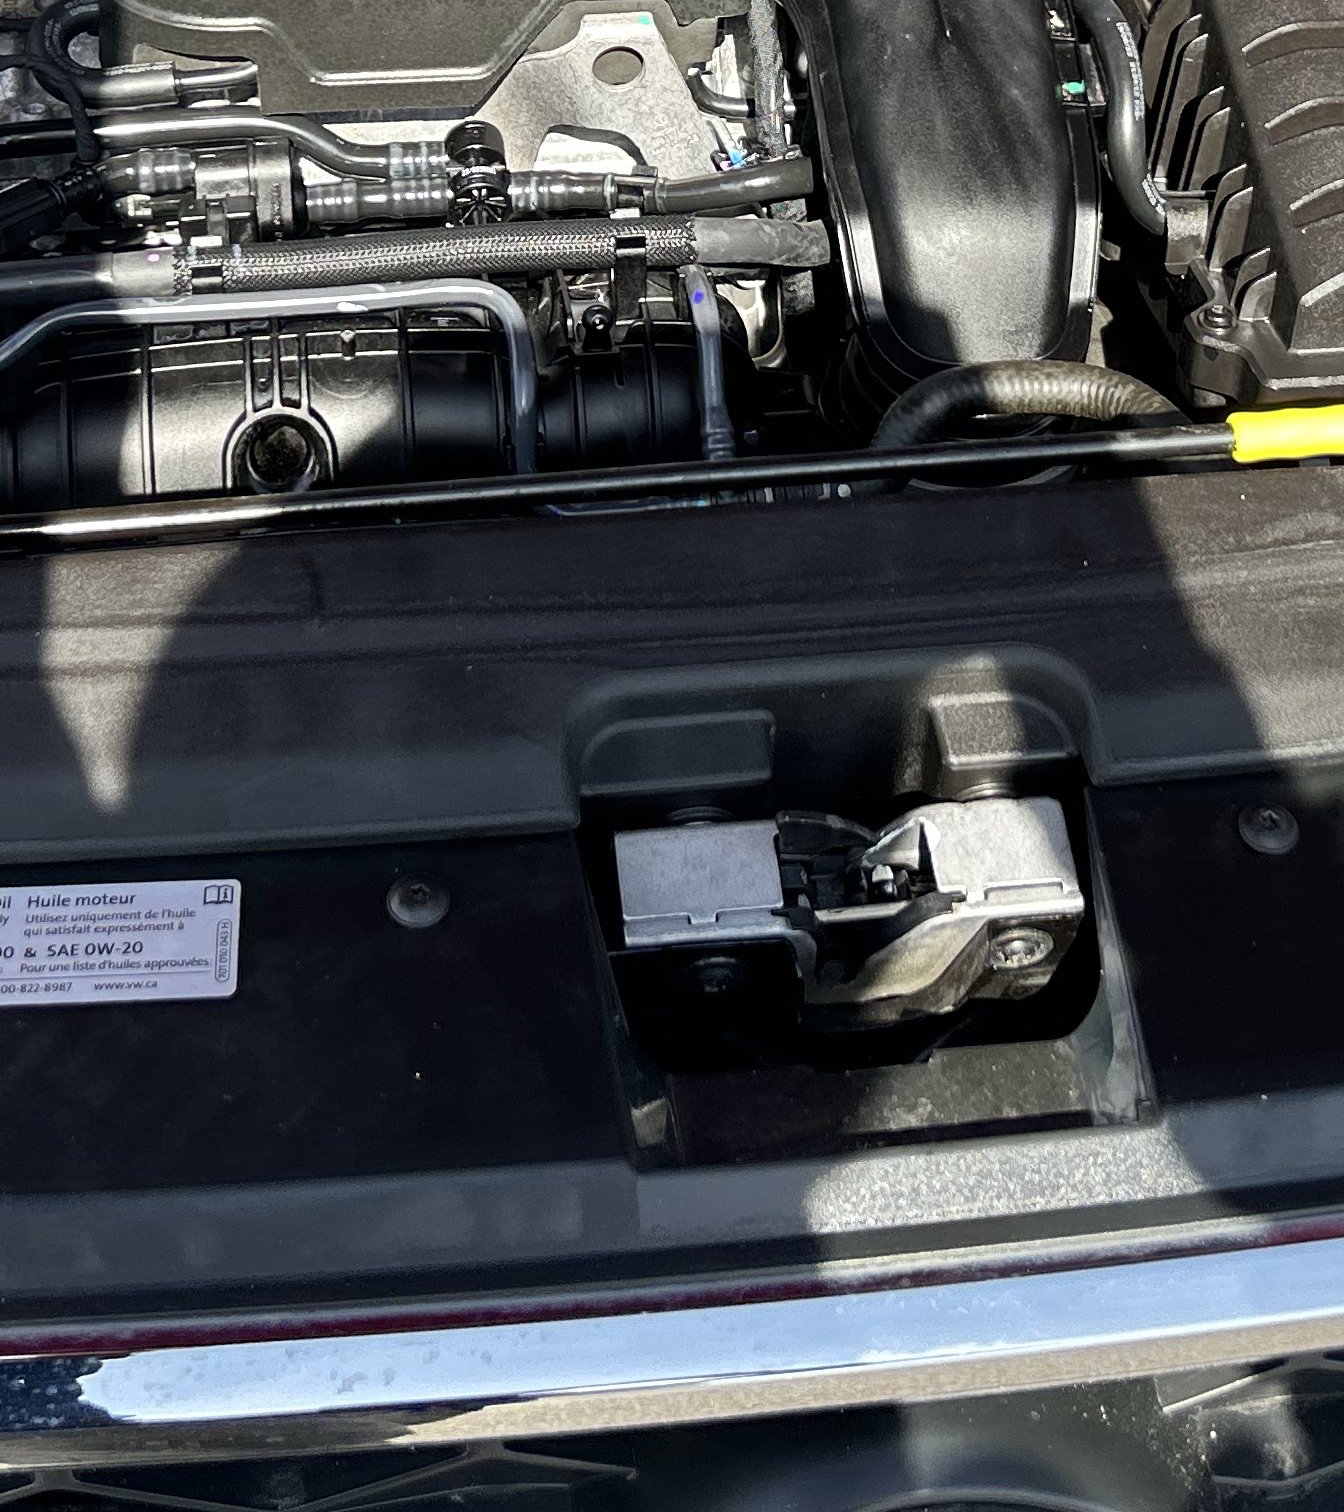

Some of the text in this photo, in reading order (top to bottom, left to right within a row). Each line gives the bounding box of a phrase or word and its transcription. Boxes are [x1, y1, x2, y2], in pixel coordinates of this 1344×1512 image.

[27, 890, 136, 909] Huile moteur
[25, 907, 196, 924] Utilisez uniquement de l'huile
[23, 920, 184, 938] qui satisfait expressément à
[23, 947, 36, 958] &
[46, 943, 80, 957] SAE
[84, 940, 143, 956] 0W-20
[19, 962, 46, 974] Pour
[49, 963, 70, 972] une
[72, 960, 96, 971] liste
[98, 958, 141, 970] d'huiles
[94, 979, 157, 991] www.vw.ca
